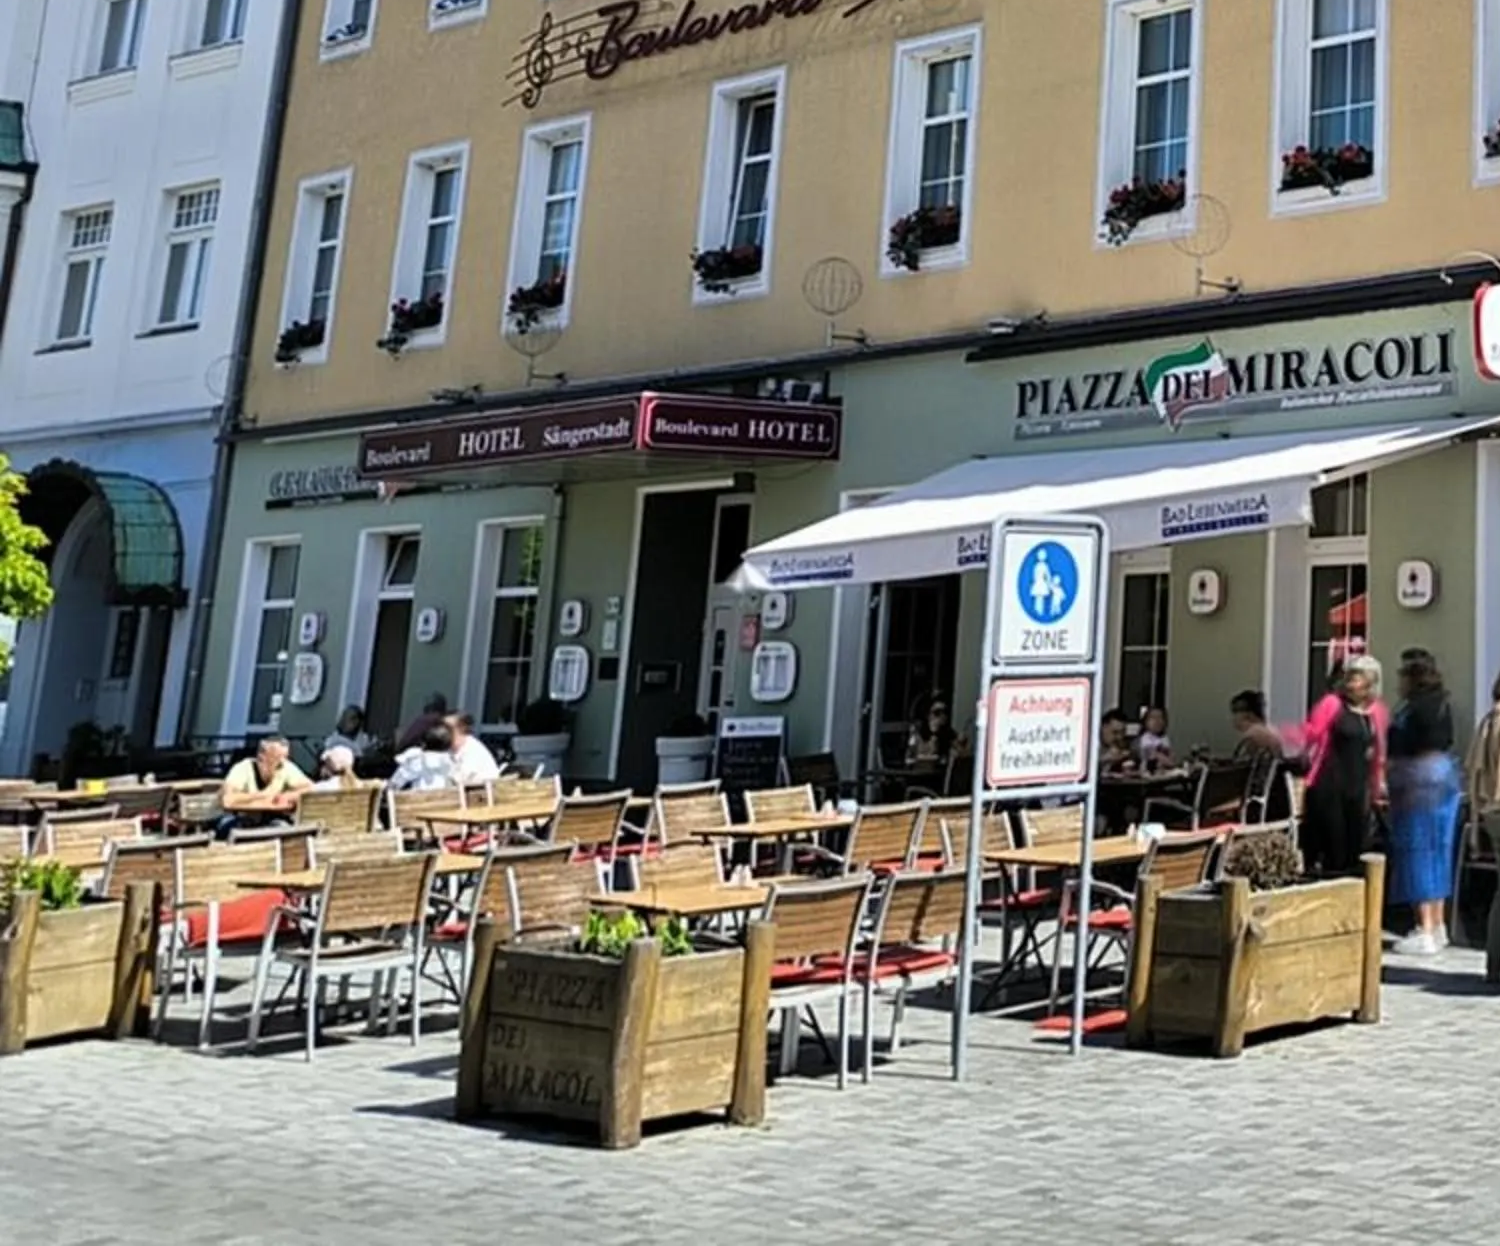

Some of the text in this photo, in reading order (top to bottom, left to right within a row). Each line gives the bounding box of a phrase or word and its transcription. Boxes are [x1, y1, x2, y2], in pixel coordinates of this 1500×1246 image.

[1015, 328, 1456, 419] PIAZZA DEI MIRACOLI
[654, 417, 832, 444] Boulevard HOTEL
[365, 418, 631, 468] Boulevard HOTEL Sängerstadt
[1021, 629, 1068, 651] ZONE
[1008, 694, 1074, 716] Achtung
[1008, 724, 1071, 744] Ausfahrt
[1001, 747, 1075, 771] freihalten!
